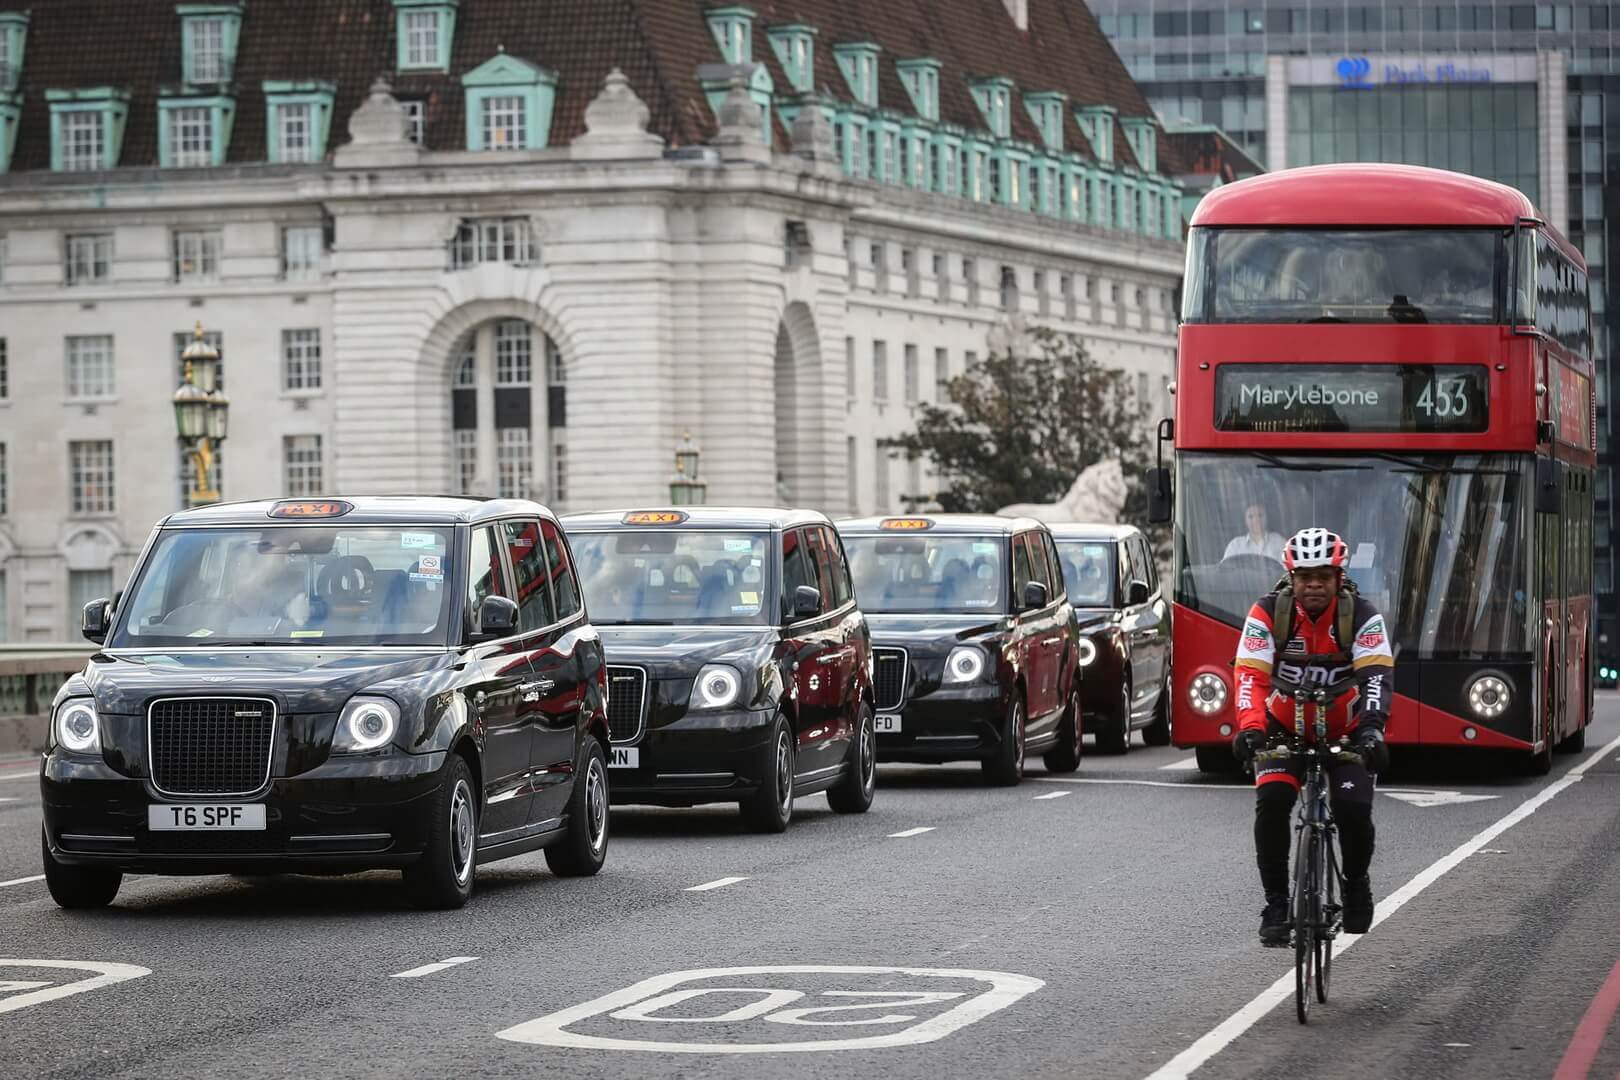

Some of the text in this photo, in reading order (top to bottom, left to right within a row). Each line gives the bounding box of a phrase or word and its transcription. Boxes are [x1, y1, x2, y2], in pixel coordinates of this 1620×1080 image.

[1240, 378, 1468, 417] Marylebone 453
[1277, 661, 1352, 687] BMC
[875, 716, 893, 730] FD
[170, 807, 243, 826] T6 SPF
[608, 988, 968, 1026] 20
